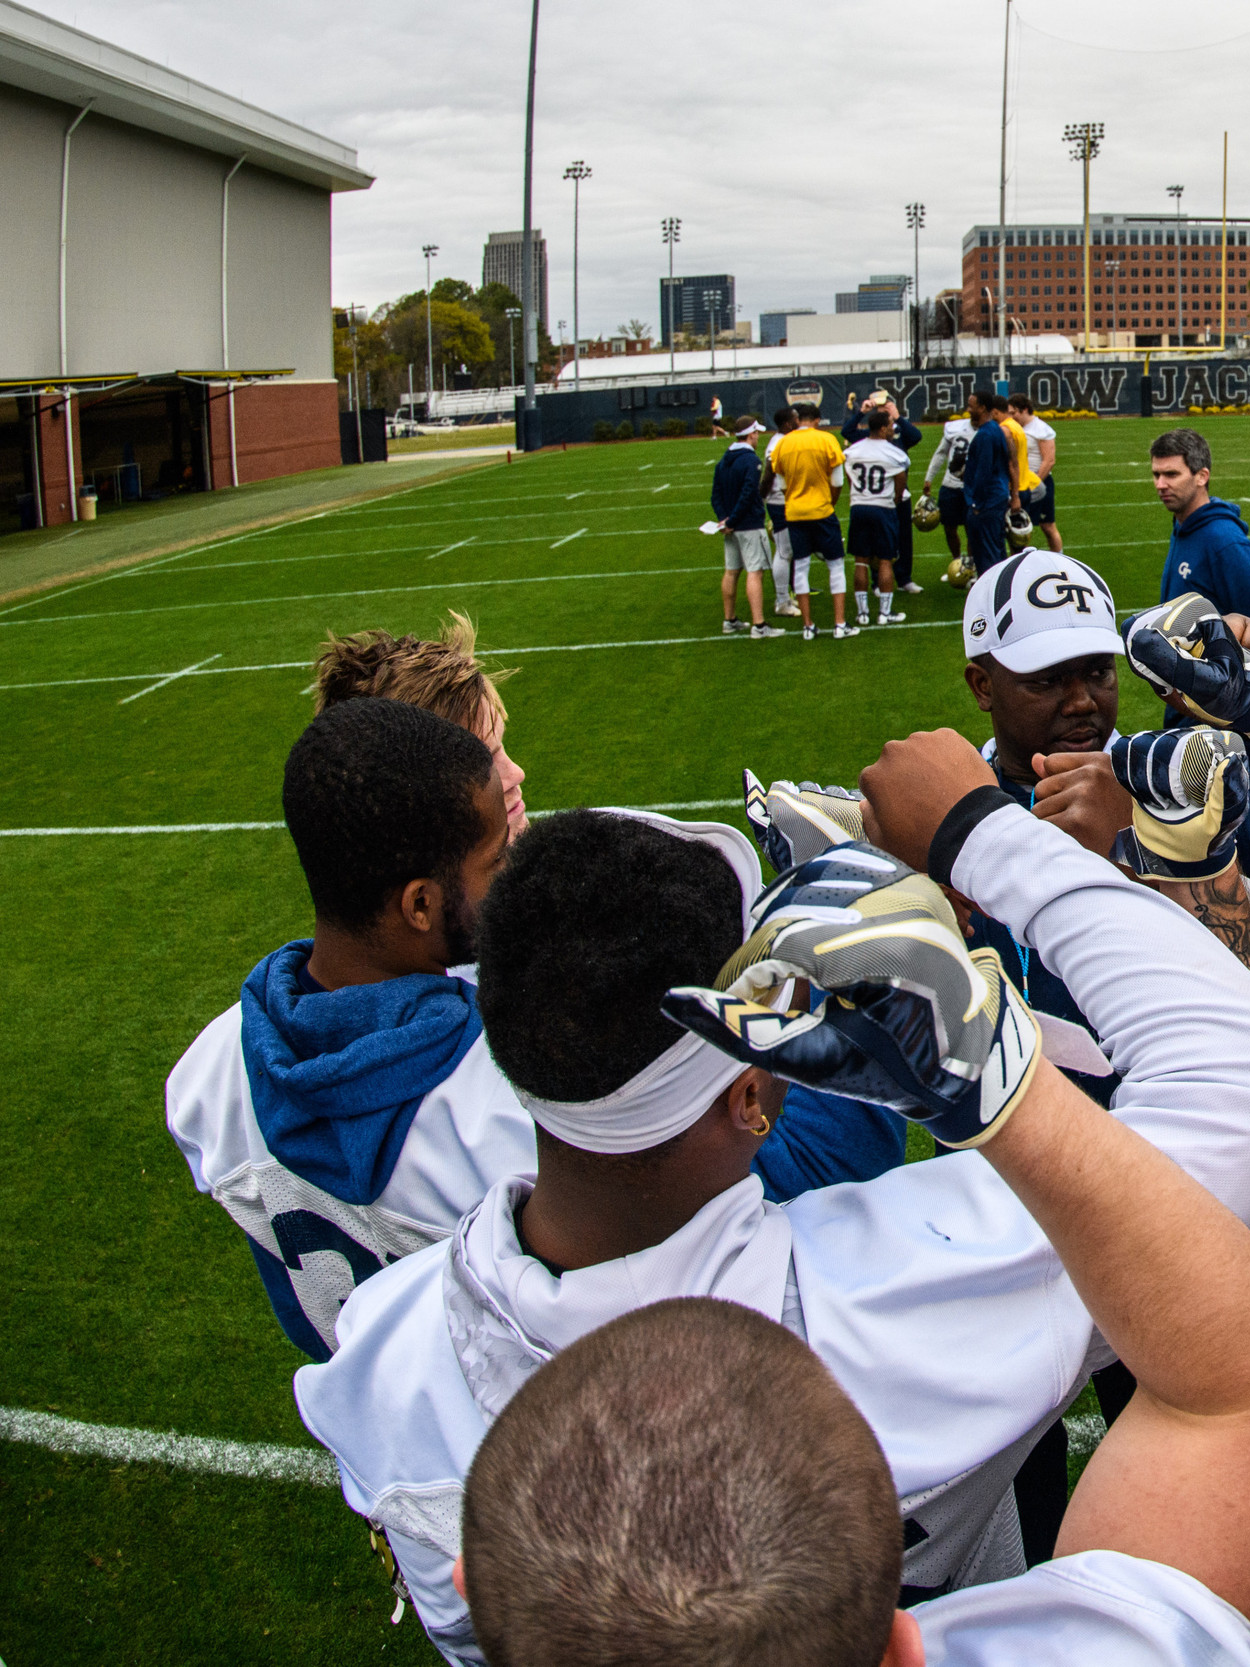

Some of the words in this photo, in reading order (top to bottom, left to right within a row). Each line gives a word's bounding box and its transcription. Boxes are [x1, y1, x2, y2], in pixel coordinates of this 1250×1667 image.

[876, 368, 1127, 419] YELOW
[852, 462, 886, 496] 30
[1178, 561, 1192, 580] GT
[1026, 571, 1095, 614] GT
[971, 619, 986, 633] ACC
